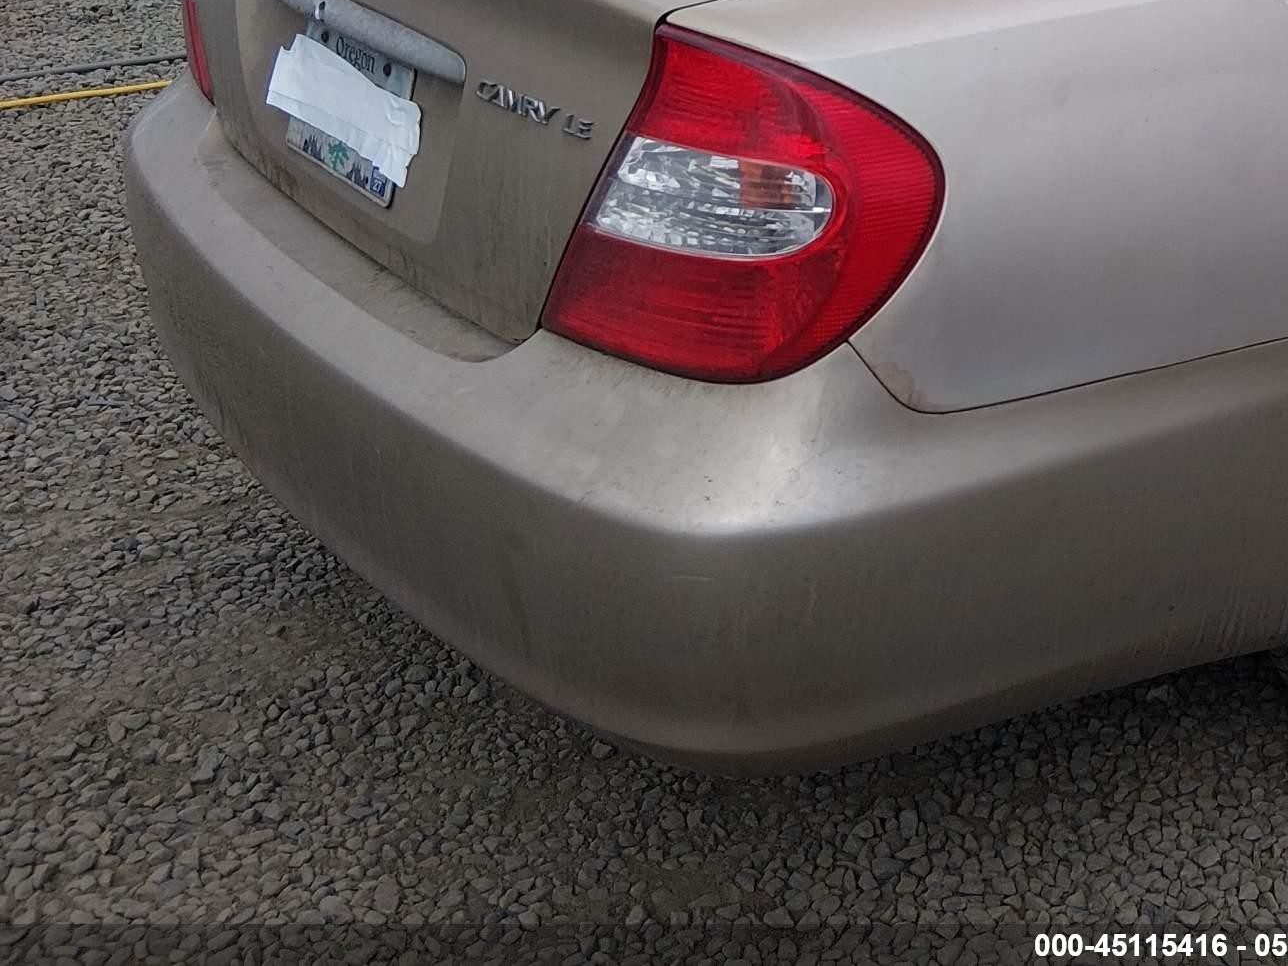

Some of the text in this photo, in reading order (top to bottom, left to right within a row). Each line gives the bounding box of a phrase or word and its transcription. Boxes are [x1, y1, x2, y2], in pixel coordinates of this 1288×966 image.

[335, 35, 377, 75] Oregon
[475, 79, 595, 140] CAMRY LE
